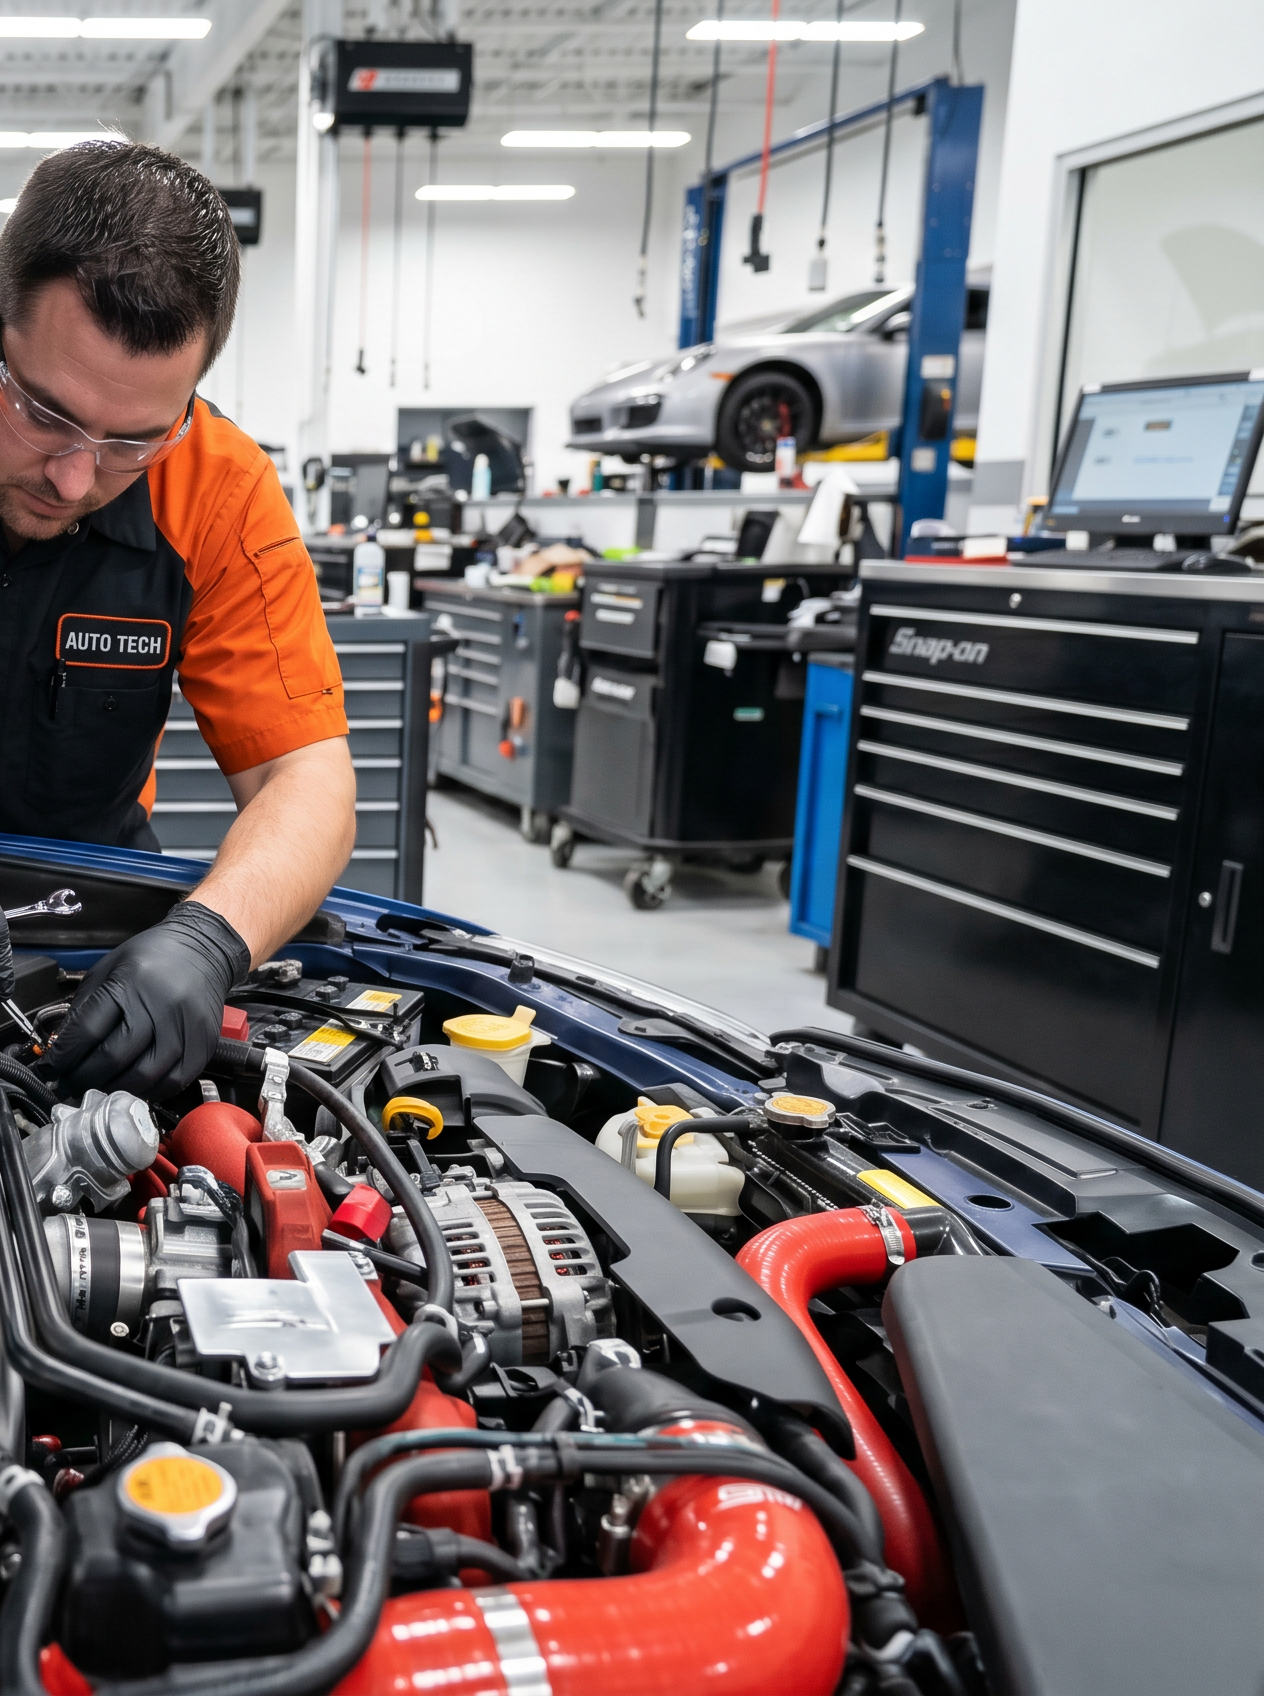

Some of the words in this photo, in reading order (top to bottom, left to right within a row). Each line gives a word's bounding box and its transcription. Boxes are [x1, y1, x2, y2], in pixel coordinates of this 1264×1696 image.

[65, 631, 112, 652] AUTO
[117, 635, 162, 654] TECH
[889, 627, 989, 665] Snap-on
